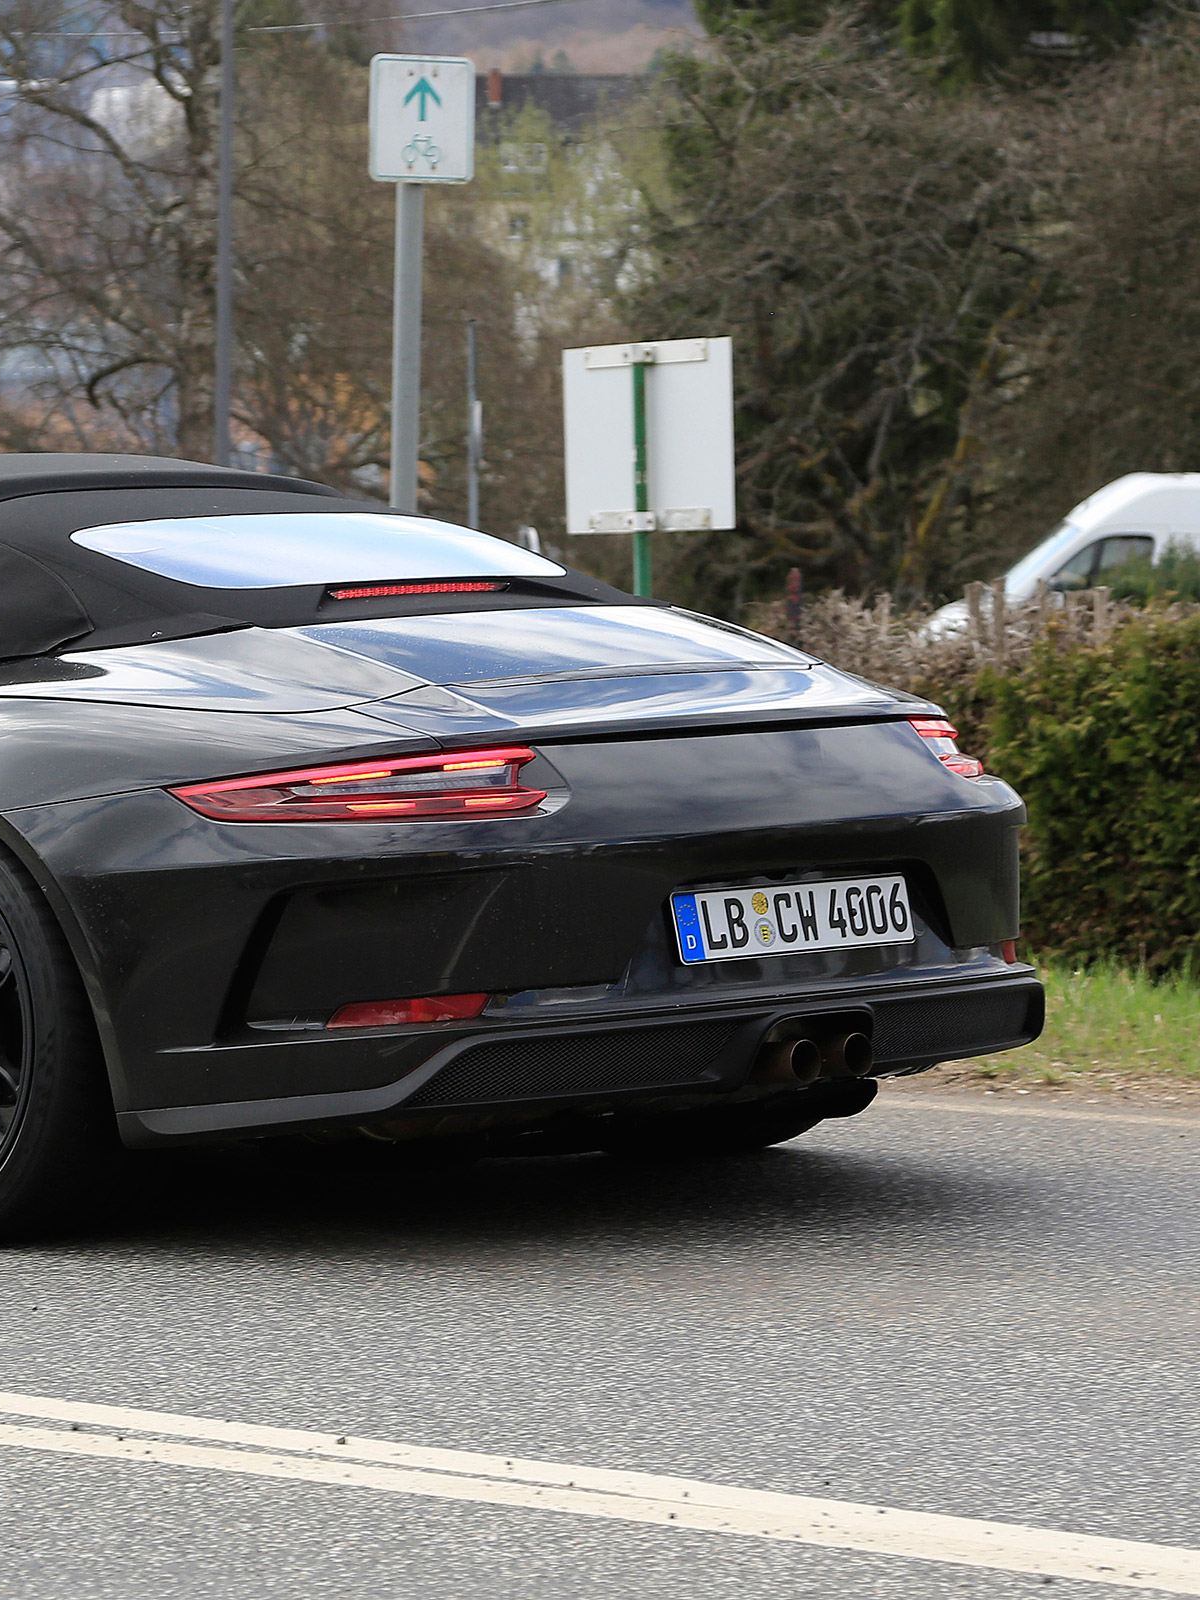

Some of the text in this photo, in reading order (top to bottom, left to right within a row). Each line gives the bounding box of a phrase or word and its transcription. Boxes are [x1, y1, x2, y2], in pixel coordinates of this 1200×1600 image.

[701, 898, 749, 950] LB
[773, 890, 819, 943] CW
[828, 883, 907, 938] 4006
[687, 934, 697, 950] D
